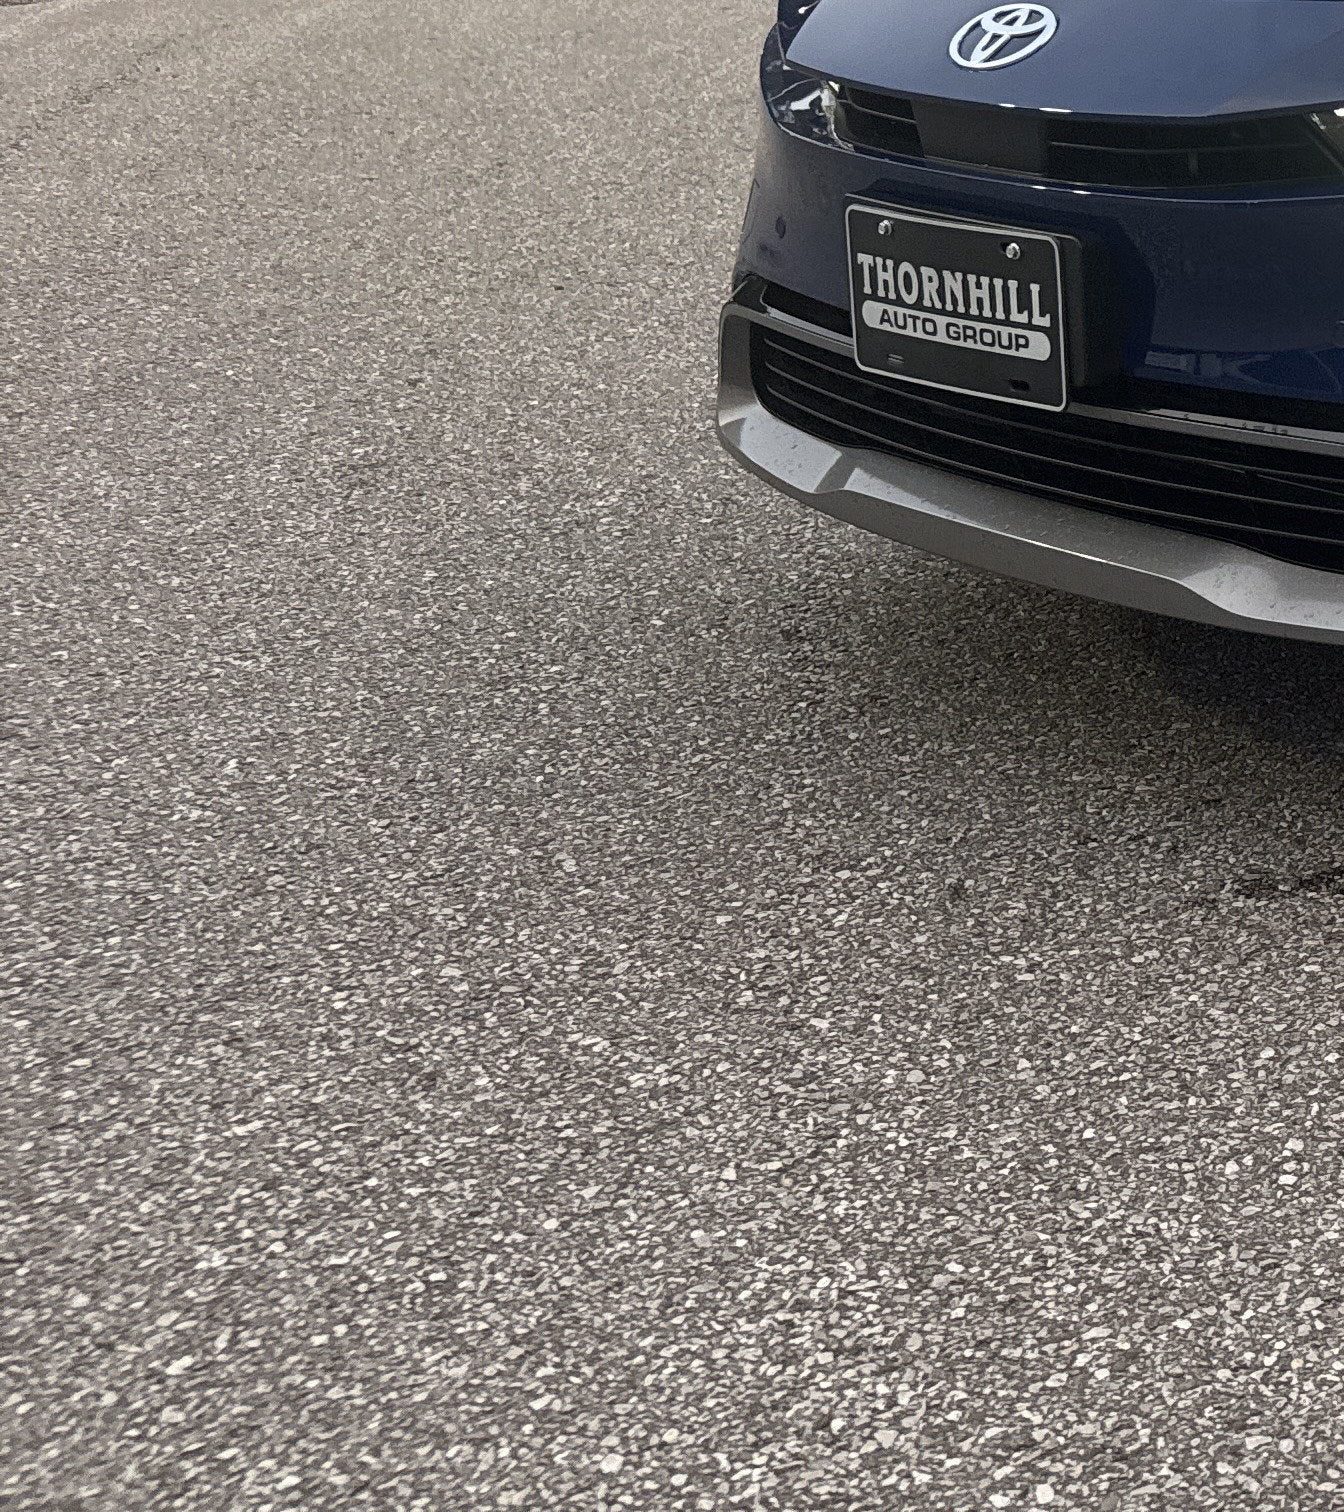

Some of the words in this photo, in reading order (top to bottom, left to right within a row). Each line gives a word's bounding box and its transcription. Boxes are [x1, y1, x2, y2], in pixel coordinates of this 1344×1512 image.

[857, 252, 1051, 327] THORNHILL
[879, 308, 937, 337] AUTO
[945, 322, 1030, 352] GROUP
